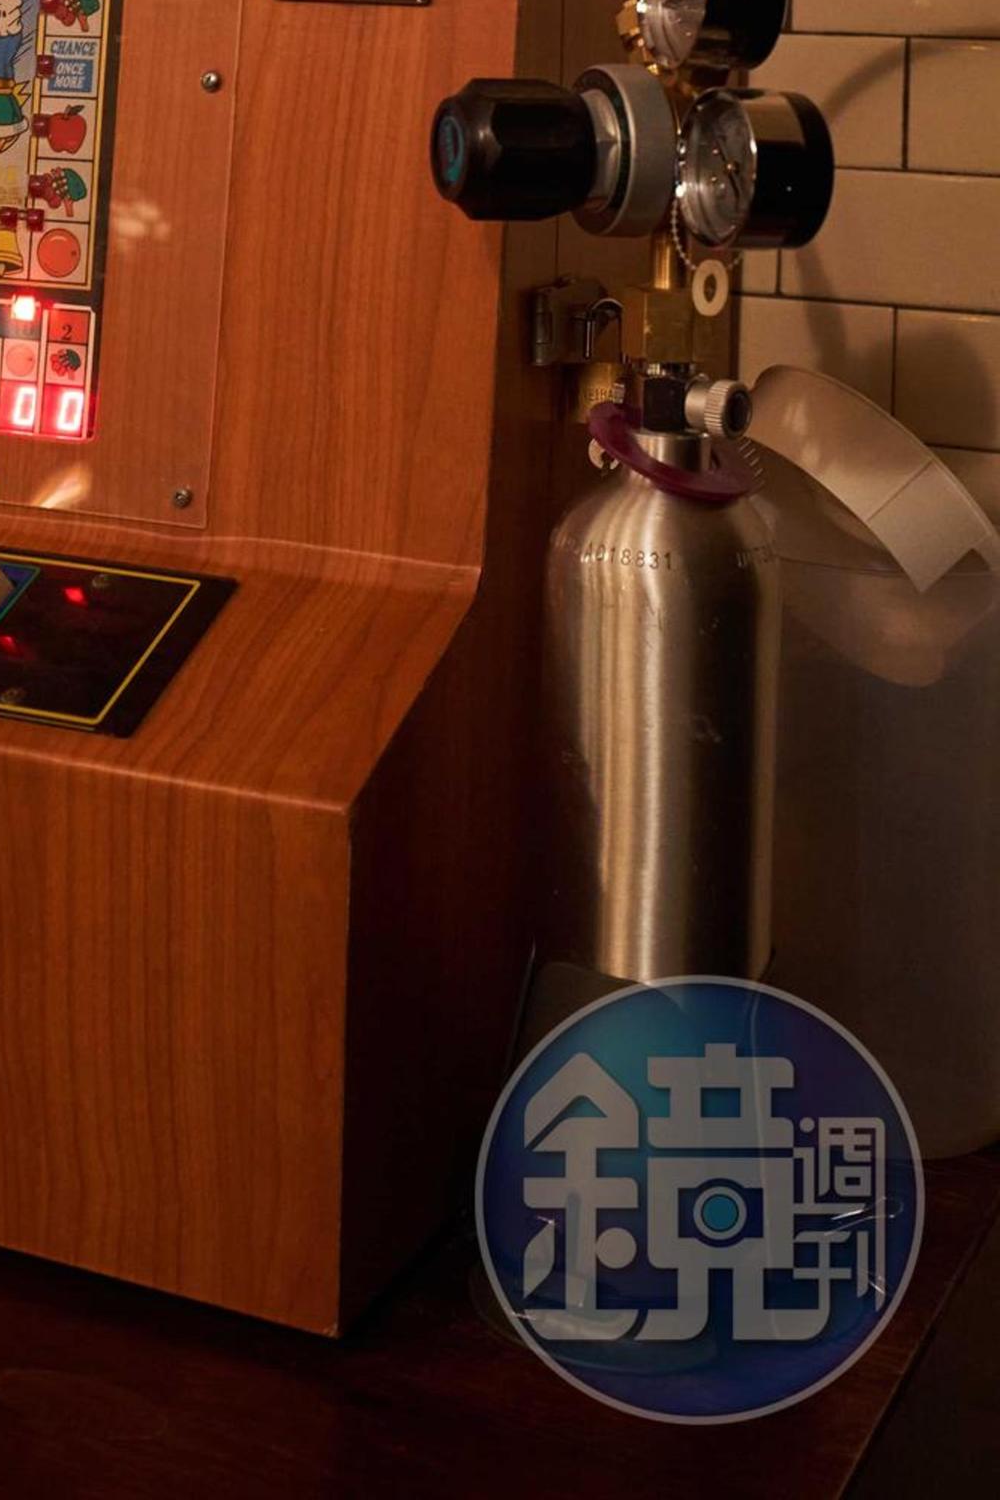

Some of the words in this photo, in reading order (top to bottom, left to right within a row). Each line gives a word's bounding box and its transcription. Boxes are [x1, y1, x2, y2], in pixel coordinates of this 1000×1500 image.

[50, 40, 98, 56] CHANCE
[56, 61, 87, 76] ONCE
[53, 75, 86, 89] MORE
[61, 324, 73, 341] 2
[12, 385, 37, 426] 0
[57, 390, 84, 431] 0
